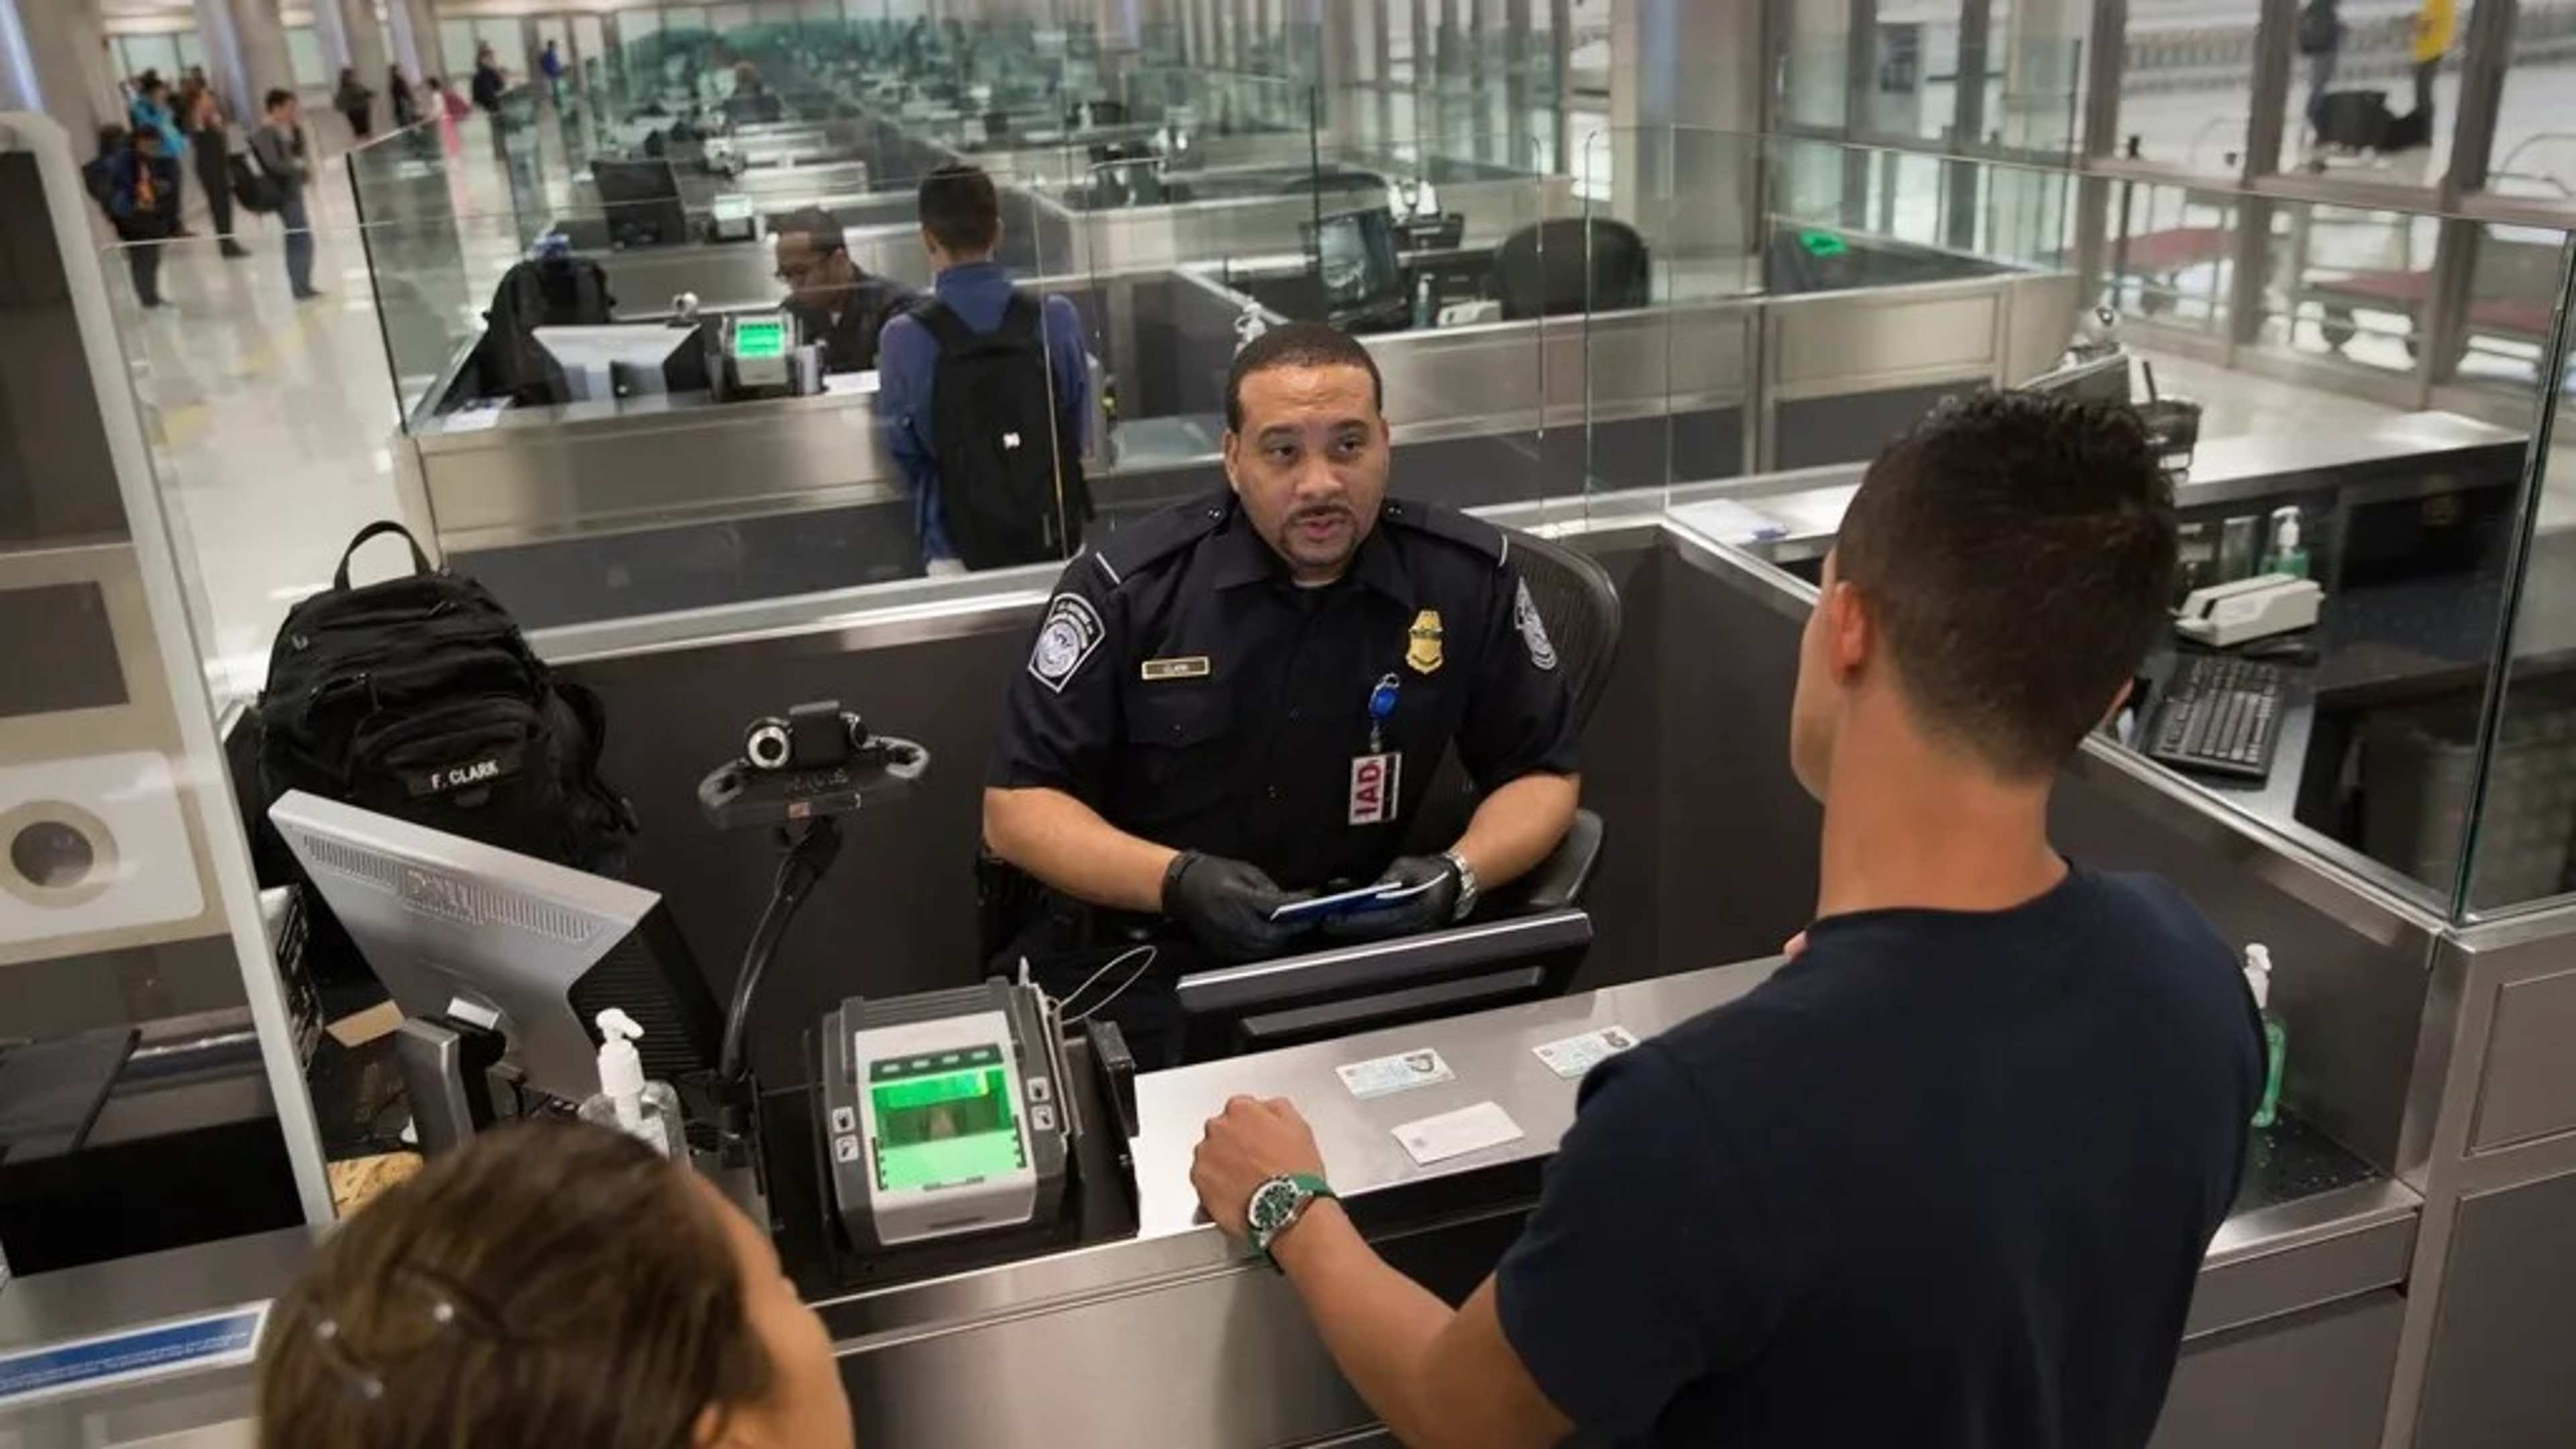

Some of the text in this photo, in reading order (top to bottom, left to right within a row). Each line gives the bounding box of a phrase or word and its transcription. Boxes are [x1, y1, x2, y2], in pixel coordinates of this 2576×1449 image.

[431, 759, 499, 790] F. CLARK
[1355, 763, 1382, 816] IAD
